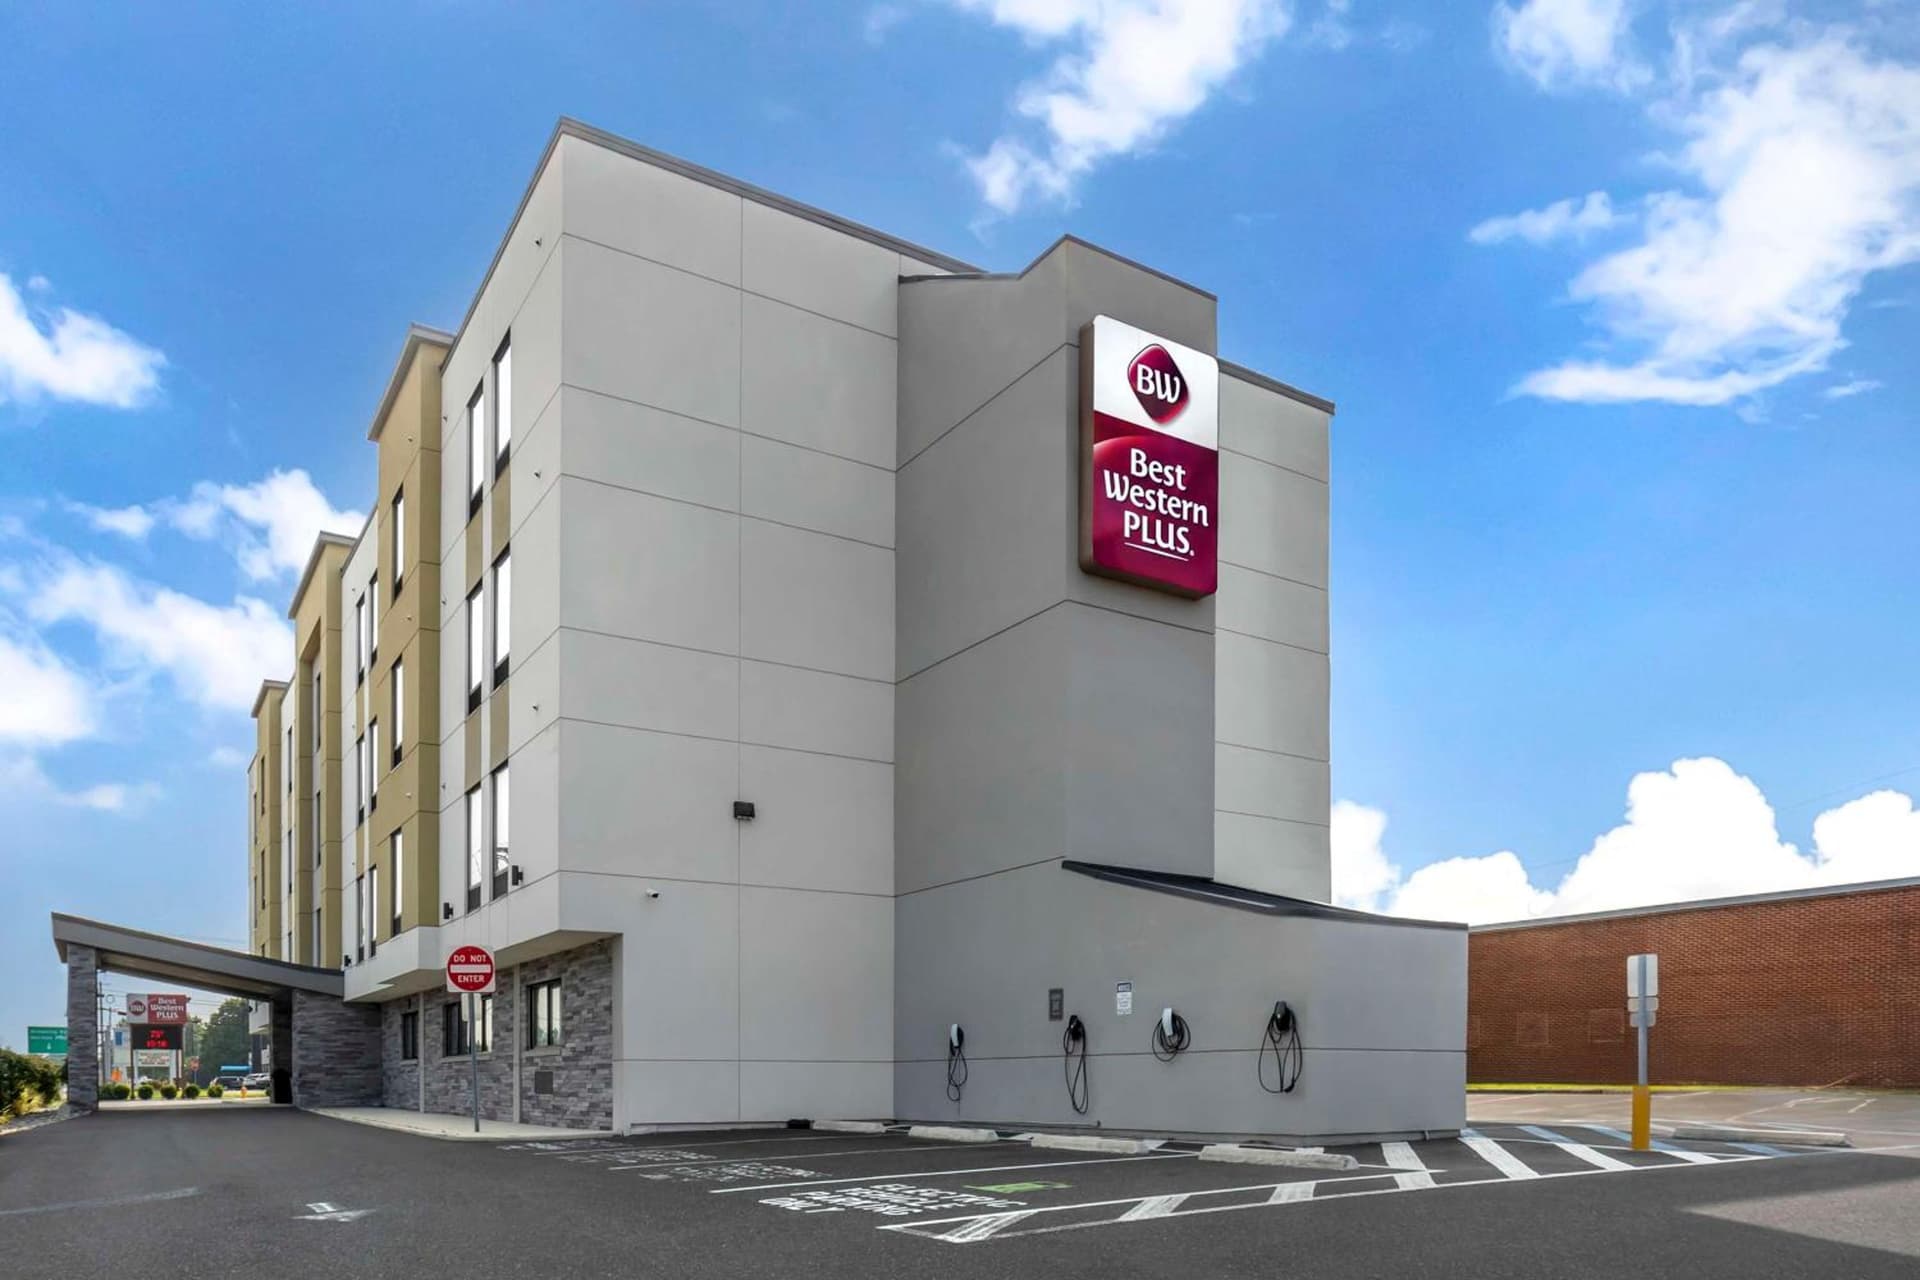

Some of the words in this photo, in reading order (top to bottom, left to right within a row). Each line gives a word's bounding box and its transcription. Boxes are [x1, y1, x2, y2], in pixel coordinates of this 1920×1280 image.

[1136, 363, 1181, 404] BW
[1130, 448, 1187, 491] Best
[1103, 469, 1209, 527] Western
[453, 954, 466, 963] DO
[470, 954, 487, 963] NOT
[457, 974, 485, 983] ENTER
[156, 1011, 178, 1019] PLUS
